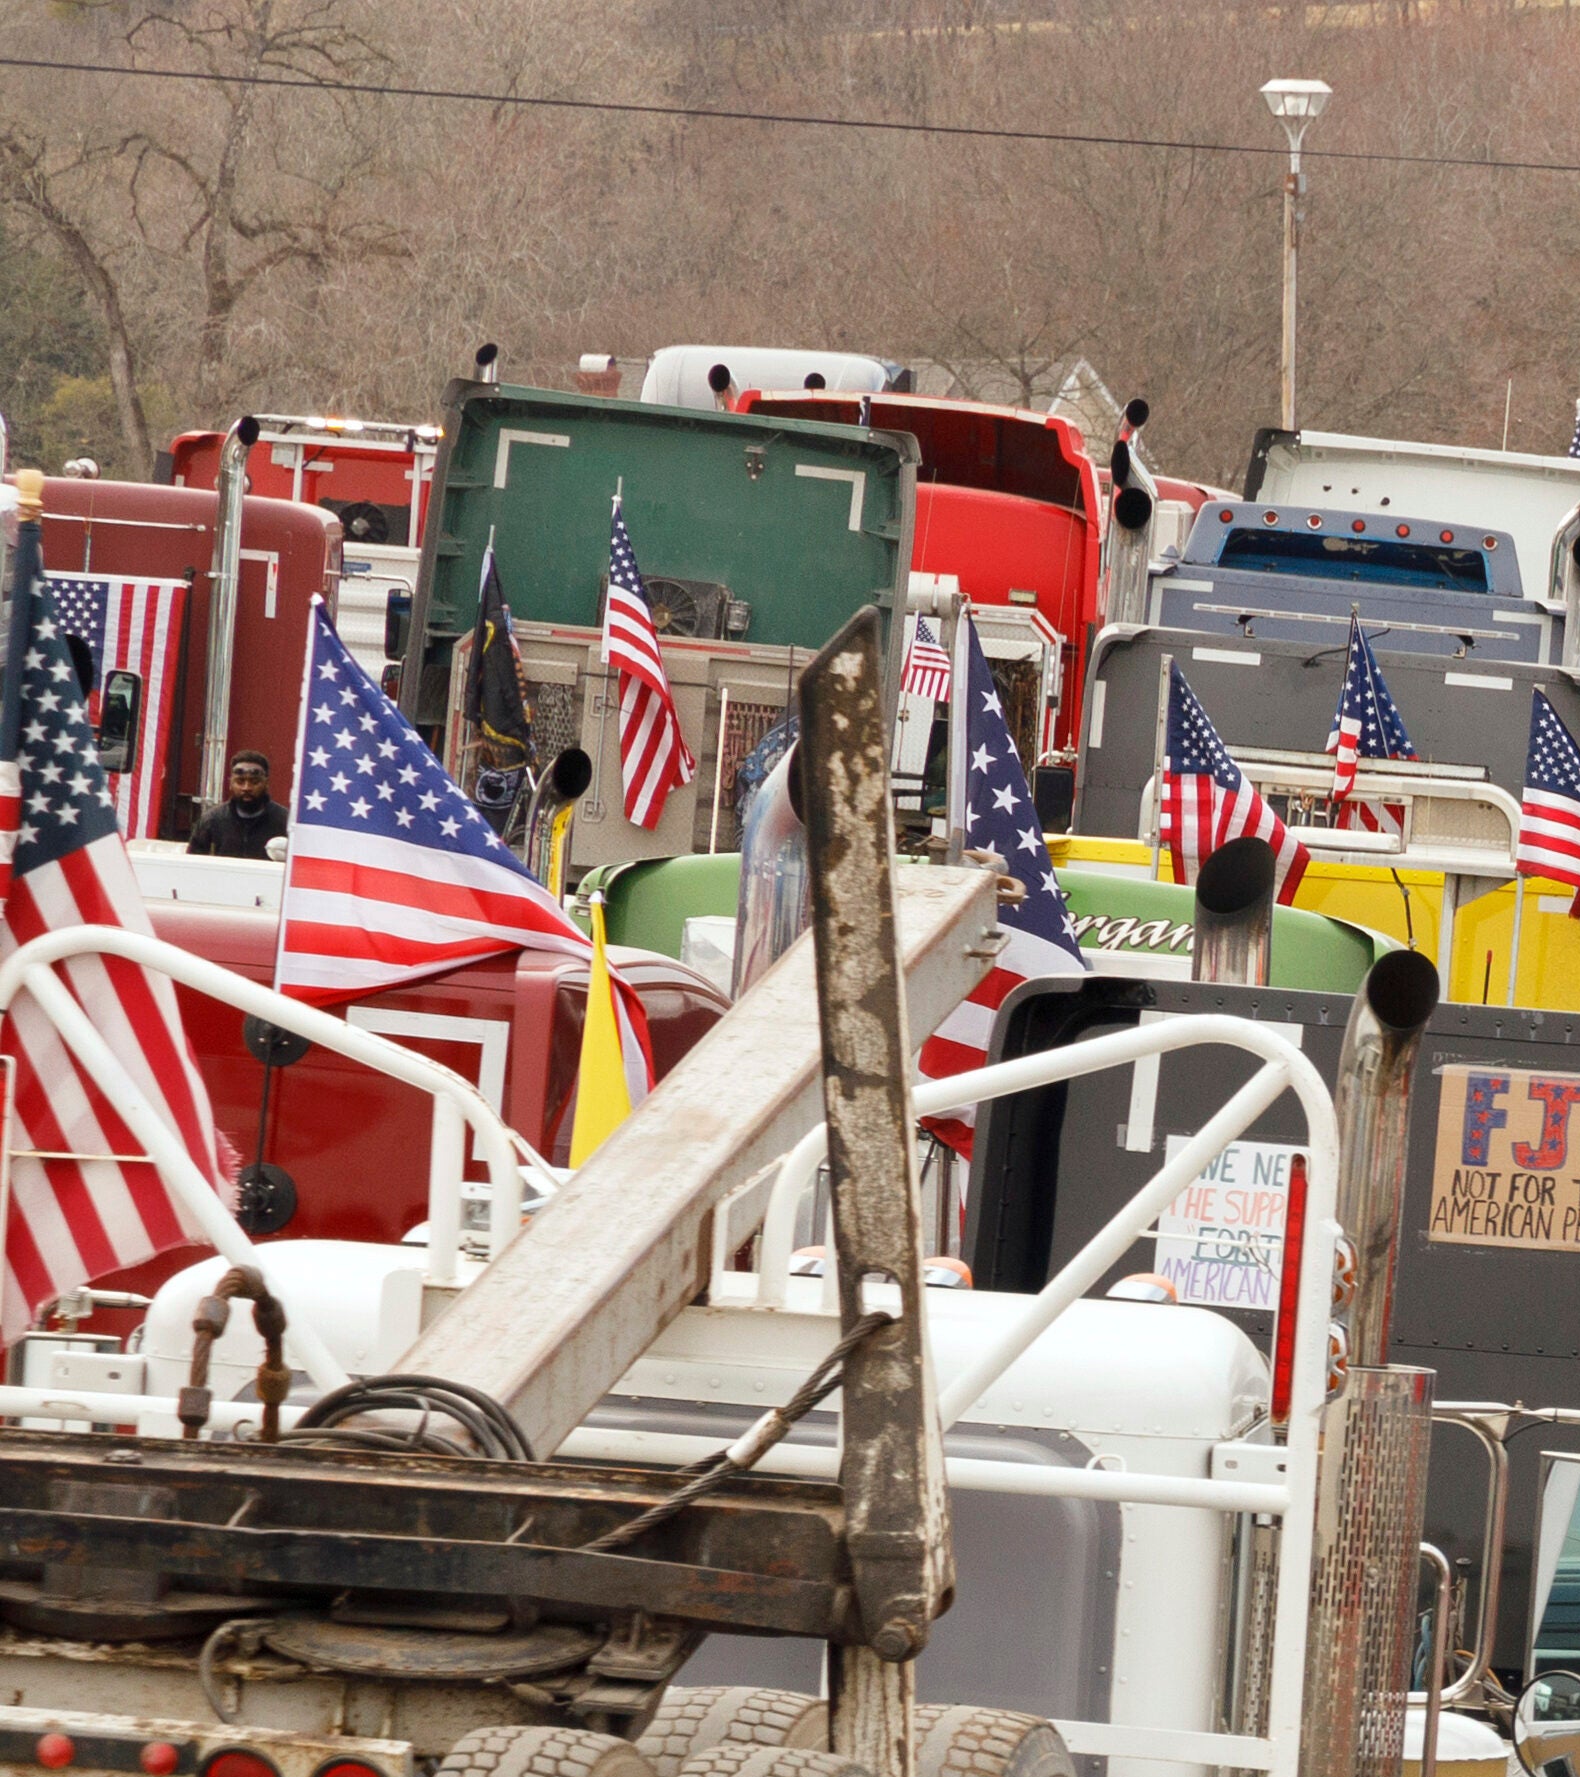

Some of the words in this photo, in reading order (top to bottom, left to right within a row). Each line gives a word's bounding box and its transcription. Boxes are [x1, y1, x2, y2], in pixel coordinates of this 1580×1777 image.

[1061, 893, 1195, 951] rgan
[1253, 1152, 1287, 1188] NE
[1451, 1170, 1501, 1203] NOT
[1509, 1173, 1556, 1208] FOR
[1223, 1190, 1288, 1229] SUPP
[1432, 1196, 1554, 1242] AMERICAN
[1161, 1257, 1273, 1305] AMERICAN
